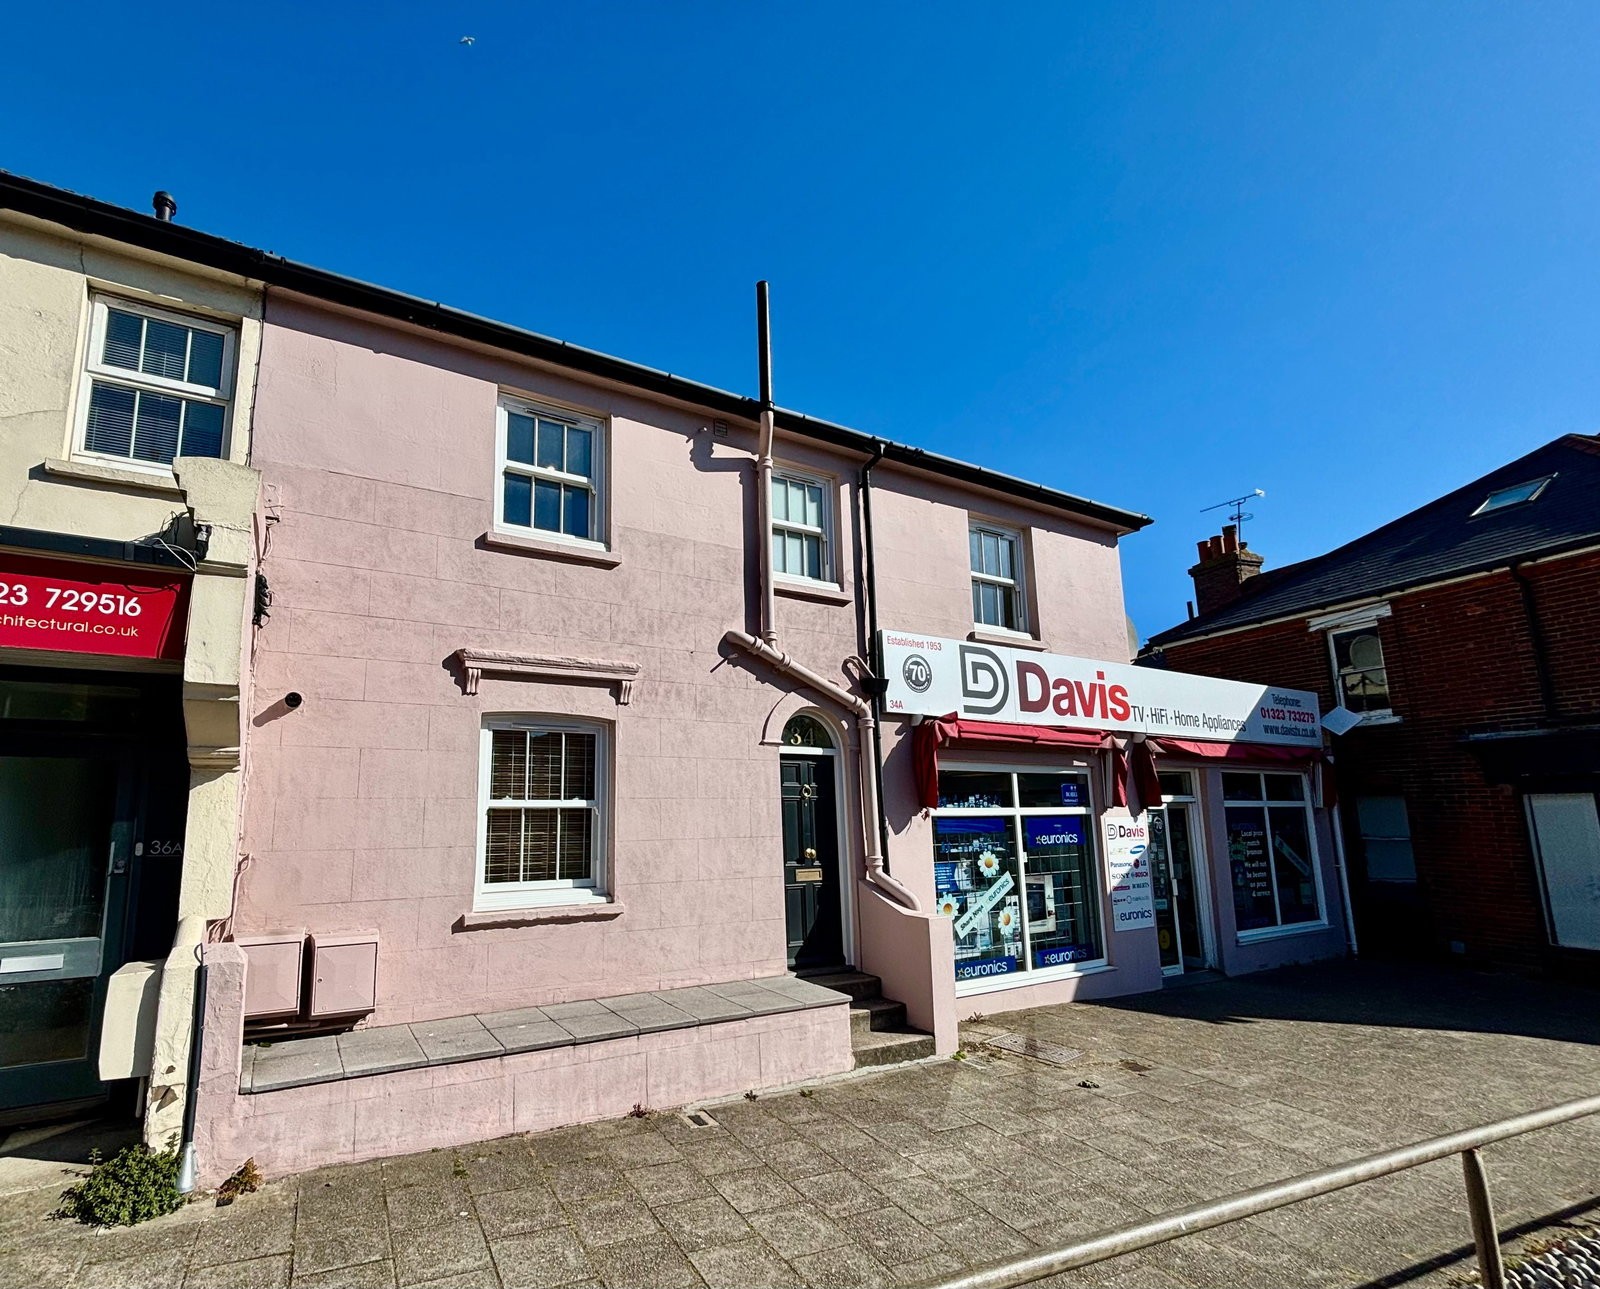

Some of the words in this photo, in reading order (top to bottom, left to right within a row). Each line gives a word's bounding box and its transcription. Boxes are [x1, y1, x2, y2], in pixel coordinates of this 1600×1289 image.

[45, 587, 142, 617] 729516
[0, 614, 139, 637] hitectural.co.uk
[887, 635, 925, 649] Established
[926, 641, 942, 651] 1953
[909, 664, 927, 682] 70
[1016, 660, 1131, 722] Davis
[889, 699, 904, 710] 34A
[1131, 705, 1145, 723] TV
[1150, 707, 1168, 725] HiFi
[1174, 709, 1200, 728] Home
[1202, 712, 1247, 733] Appliances
[1260, 707, 1286, 721] 01323
[1287, 710, 1315, 724] 733279
[790, 728, 814, 745] 34
[1041, 831, 1078, 845] euronics
[1118, 824, 1145, 838] Davis
[150, 840, 183, 855] 36A
[1111, 872, 1130, 880] SONY
[988, 878, 1010, 902] euronics
[1120, 909, 1152, 922] euronics
[1050, 947, 1088, 965] euronics
[964, 960, 1008, 978] euronics
